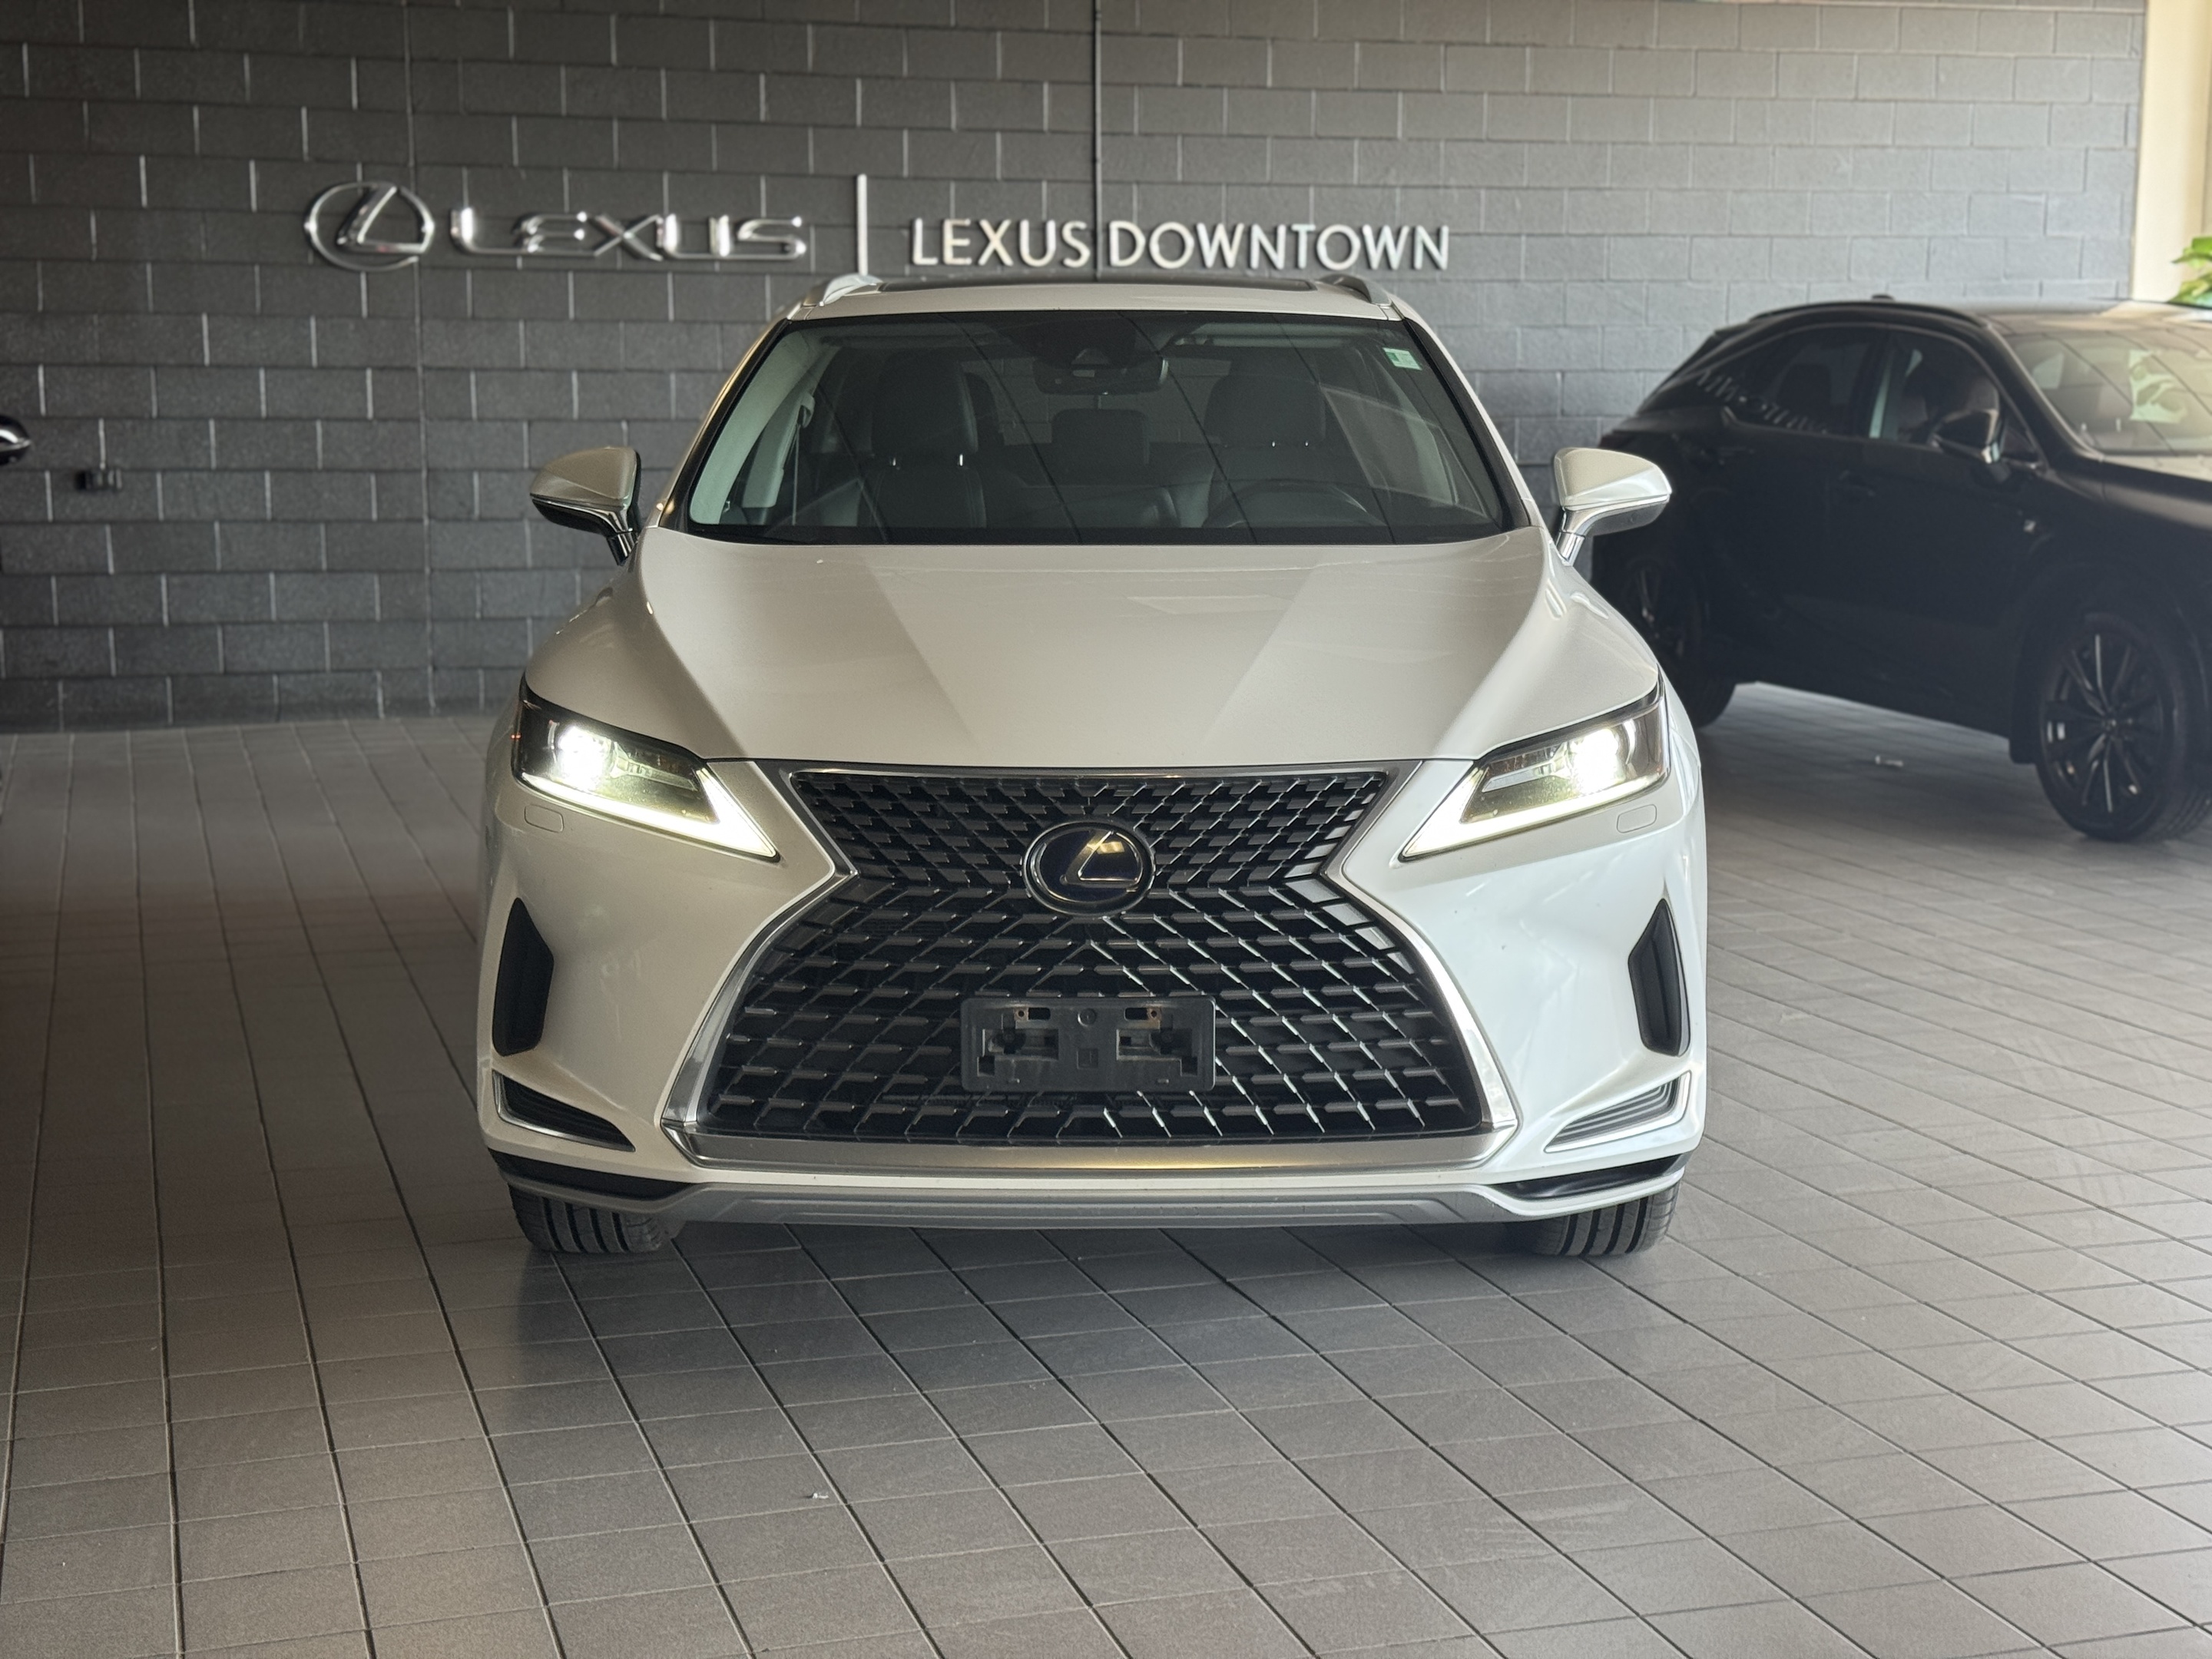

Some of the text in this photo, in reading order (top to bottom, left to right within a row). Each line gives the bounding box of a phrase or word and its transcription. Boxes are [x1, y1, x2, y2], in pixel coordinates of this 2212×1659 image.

[450, 207, 807, 262] LEXUS
[912, 217, 1450, 271] LEXUS DOWNTOWN
